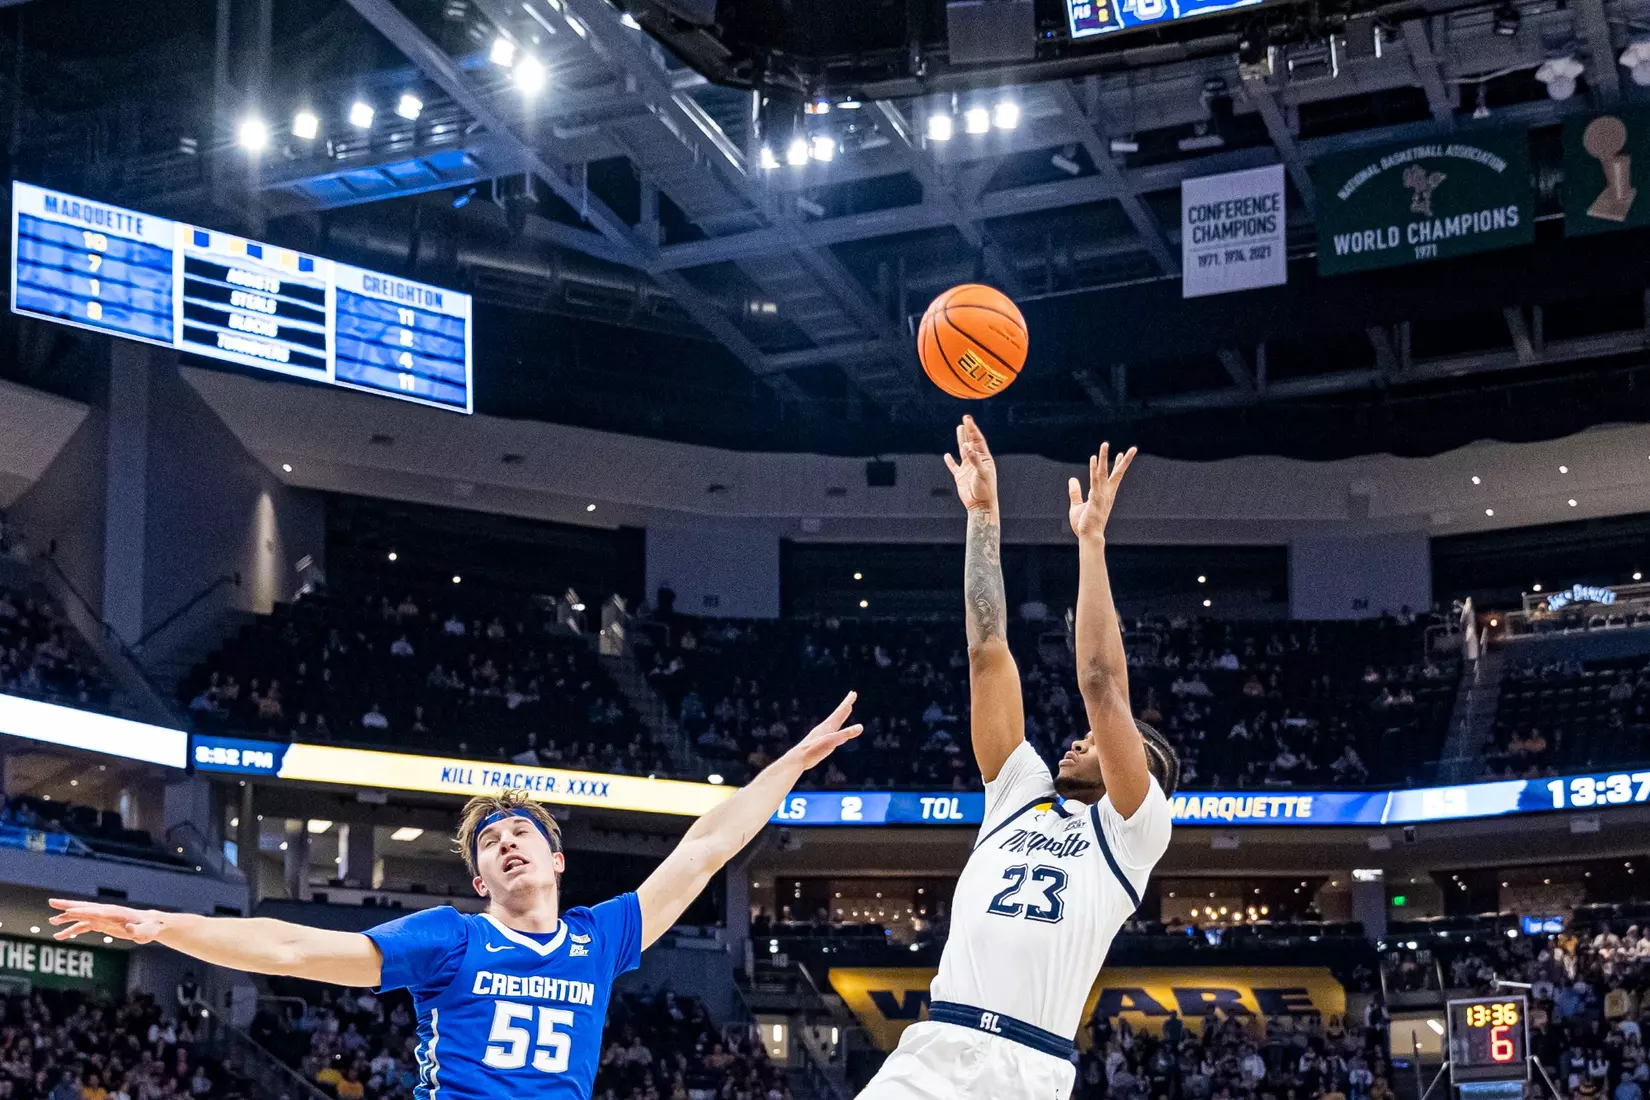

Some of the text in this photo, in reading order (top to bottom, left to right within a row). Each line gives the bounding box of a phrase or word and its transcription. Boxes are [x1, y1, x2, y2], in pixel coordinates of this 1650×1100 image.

[1337, 144, 1508, 200] NATIONAL BASKETBALL ASSOCIATION
[44, 194, 143, 236] MARQUETTE
[1188, 192, 1280, 224] CONFERENCE
[1192, 214, 1277, 244] CHAMPIONS
[1333, 205, 1520, 256] WORLD CHAMPIONS
[1415, 244, 1438, 259] 1971
[90, 279, 100, 297] 1
[363, 274, 443, 309] CREIGHTON
[958, 353, 1004, 390] ELITE
[242, 750, 273, 769] PM
[441, 767, 610, 797] KILL TRACKER: XXXX
[1169, 796, 1313, 821] MARQUETTE
[1547, 772, 1650, 809] 13:37
[777, 796, 963, 820] LS 2 TOL
[986, 863, 1068, 924] 23
[0, 940, 94, 978] THE DEER
[472, 970, 595, 1006] CREIGHTON
[866, 988, 1321, 1020] W ARE
[1466, 1003, 1518, 1027] 13:36
[481, 1000, 574, 1073] 55
[1490, 1025, 1514, 1063] 6
